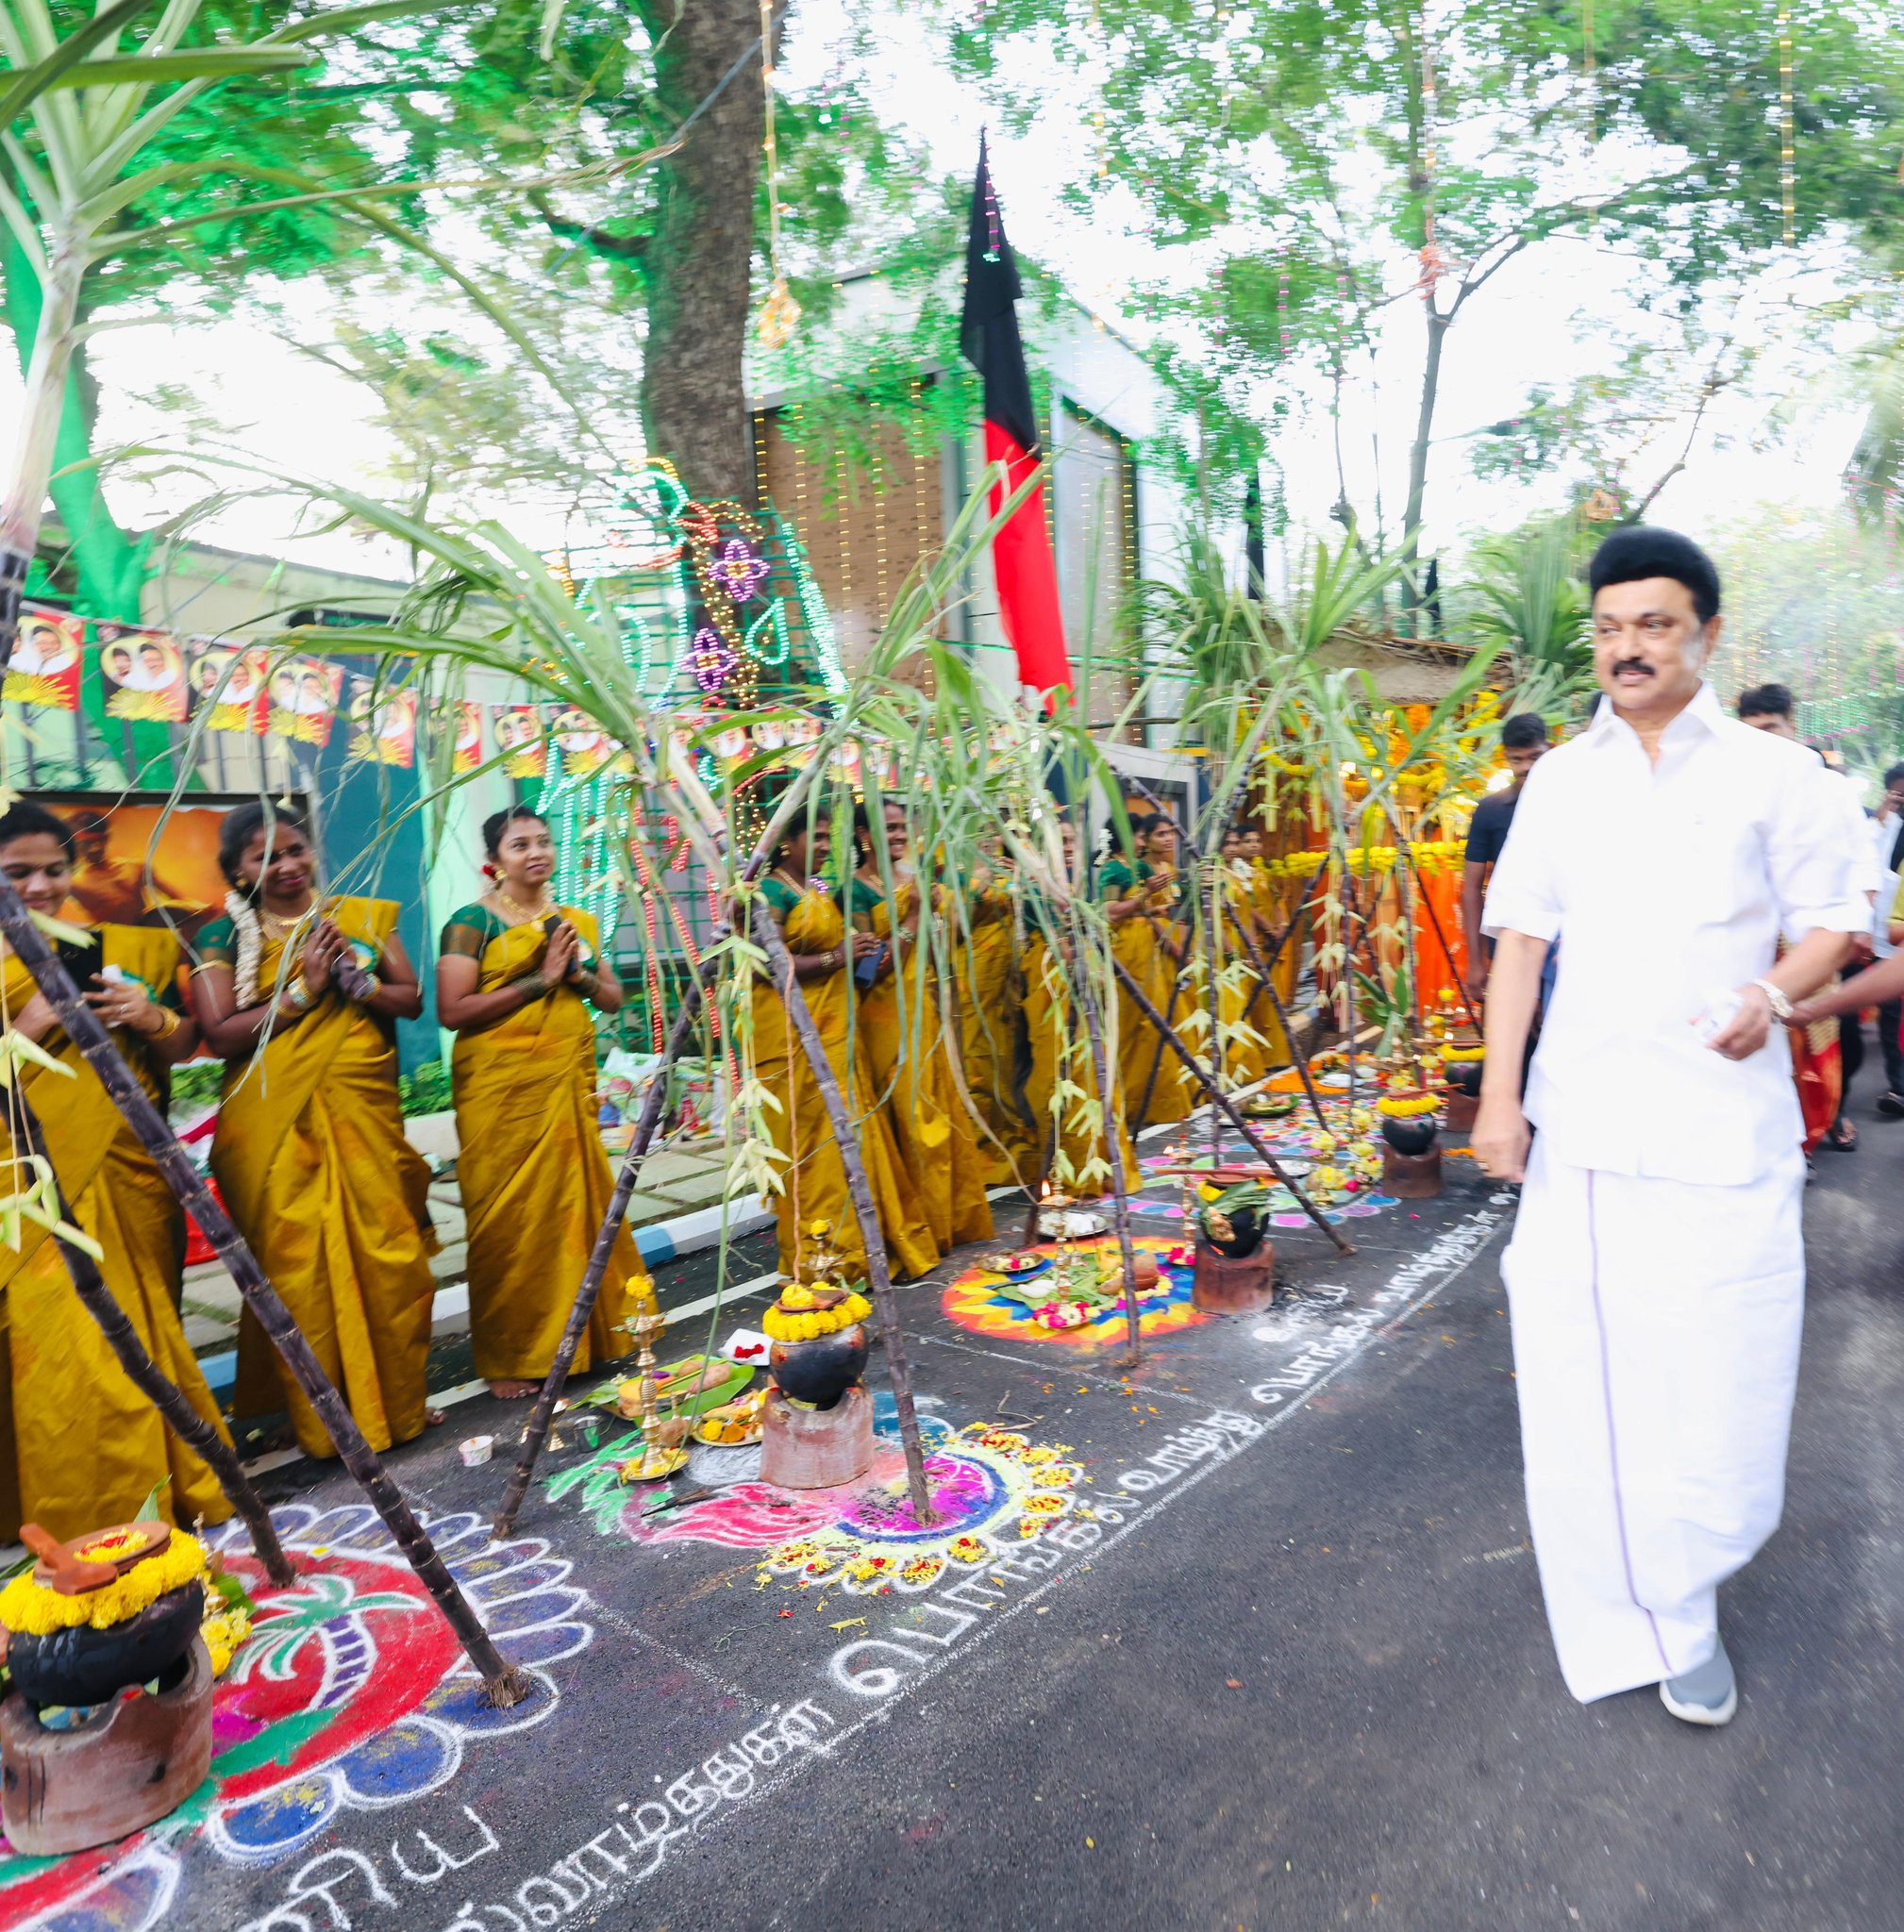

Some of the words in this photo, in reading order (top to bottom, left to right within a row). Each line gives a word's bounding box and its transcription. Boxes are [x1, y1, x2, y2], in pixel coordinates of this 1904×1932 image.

[516, 1699, 835, 1927] வாழ்த்துகள்
[830, 1491, 1143, 1696] பொங்கல்
[1251, 1307, 1385, 1404] பொங்கல்
